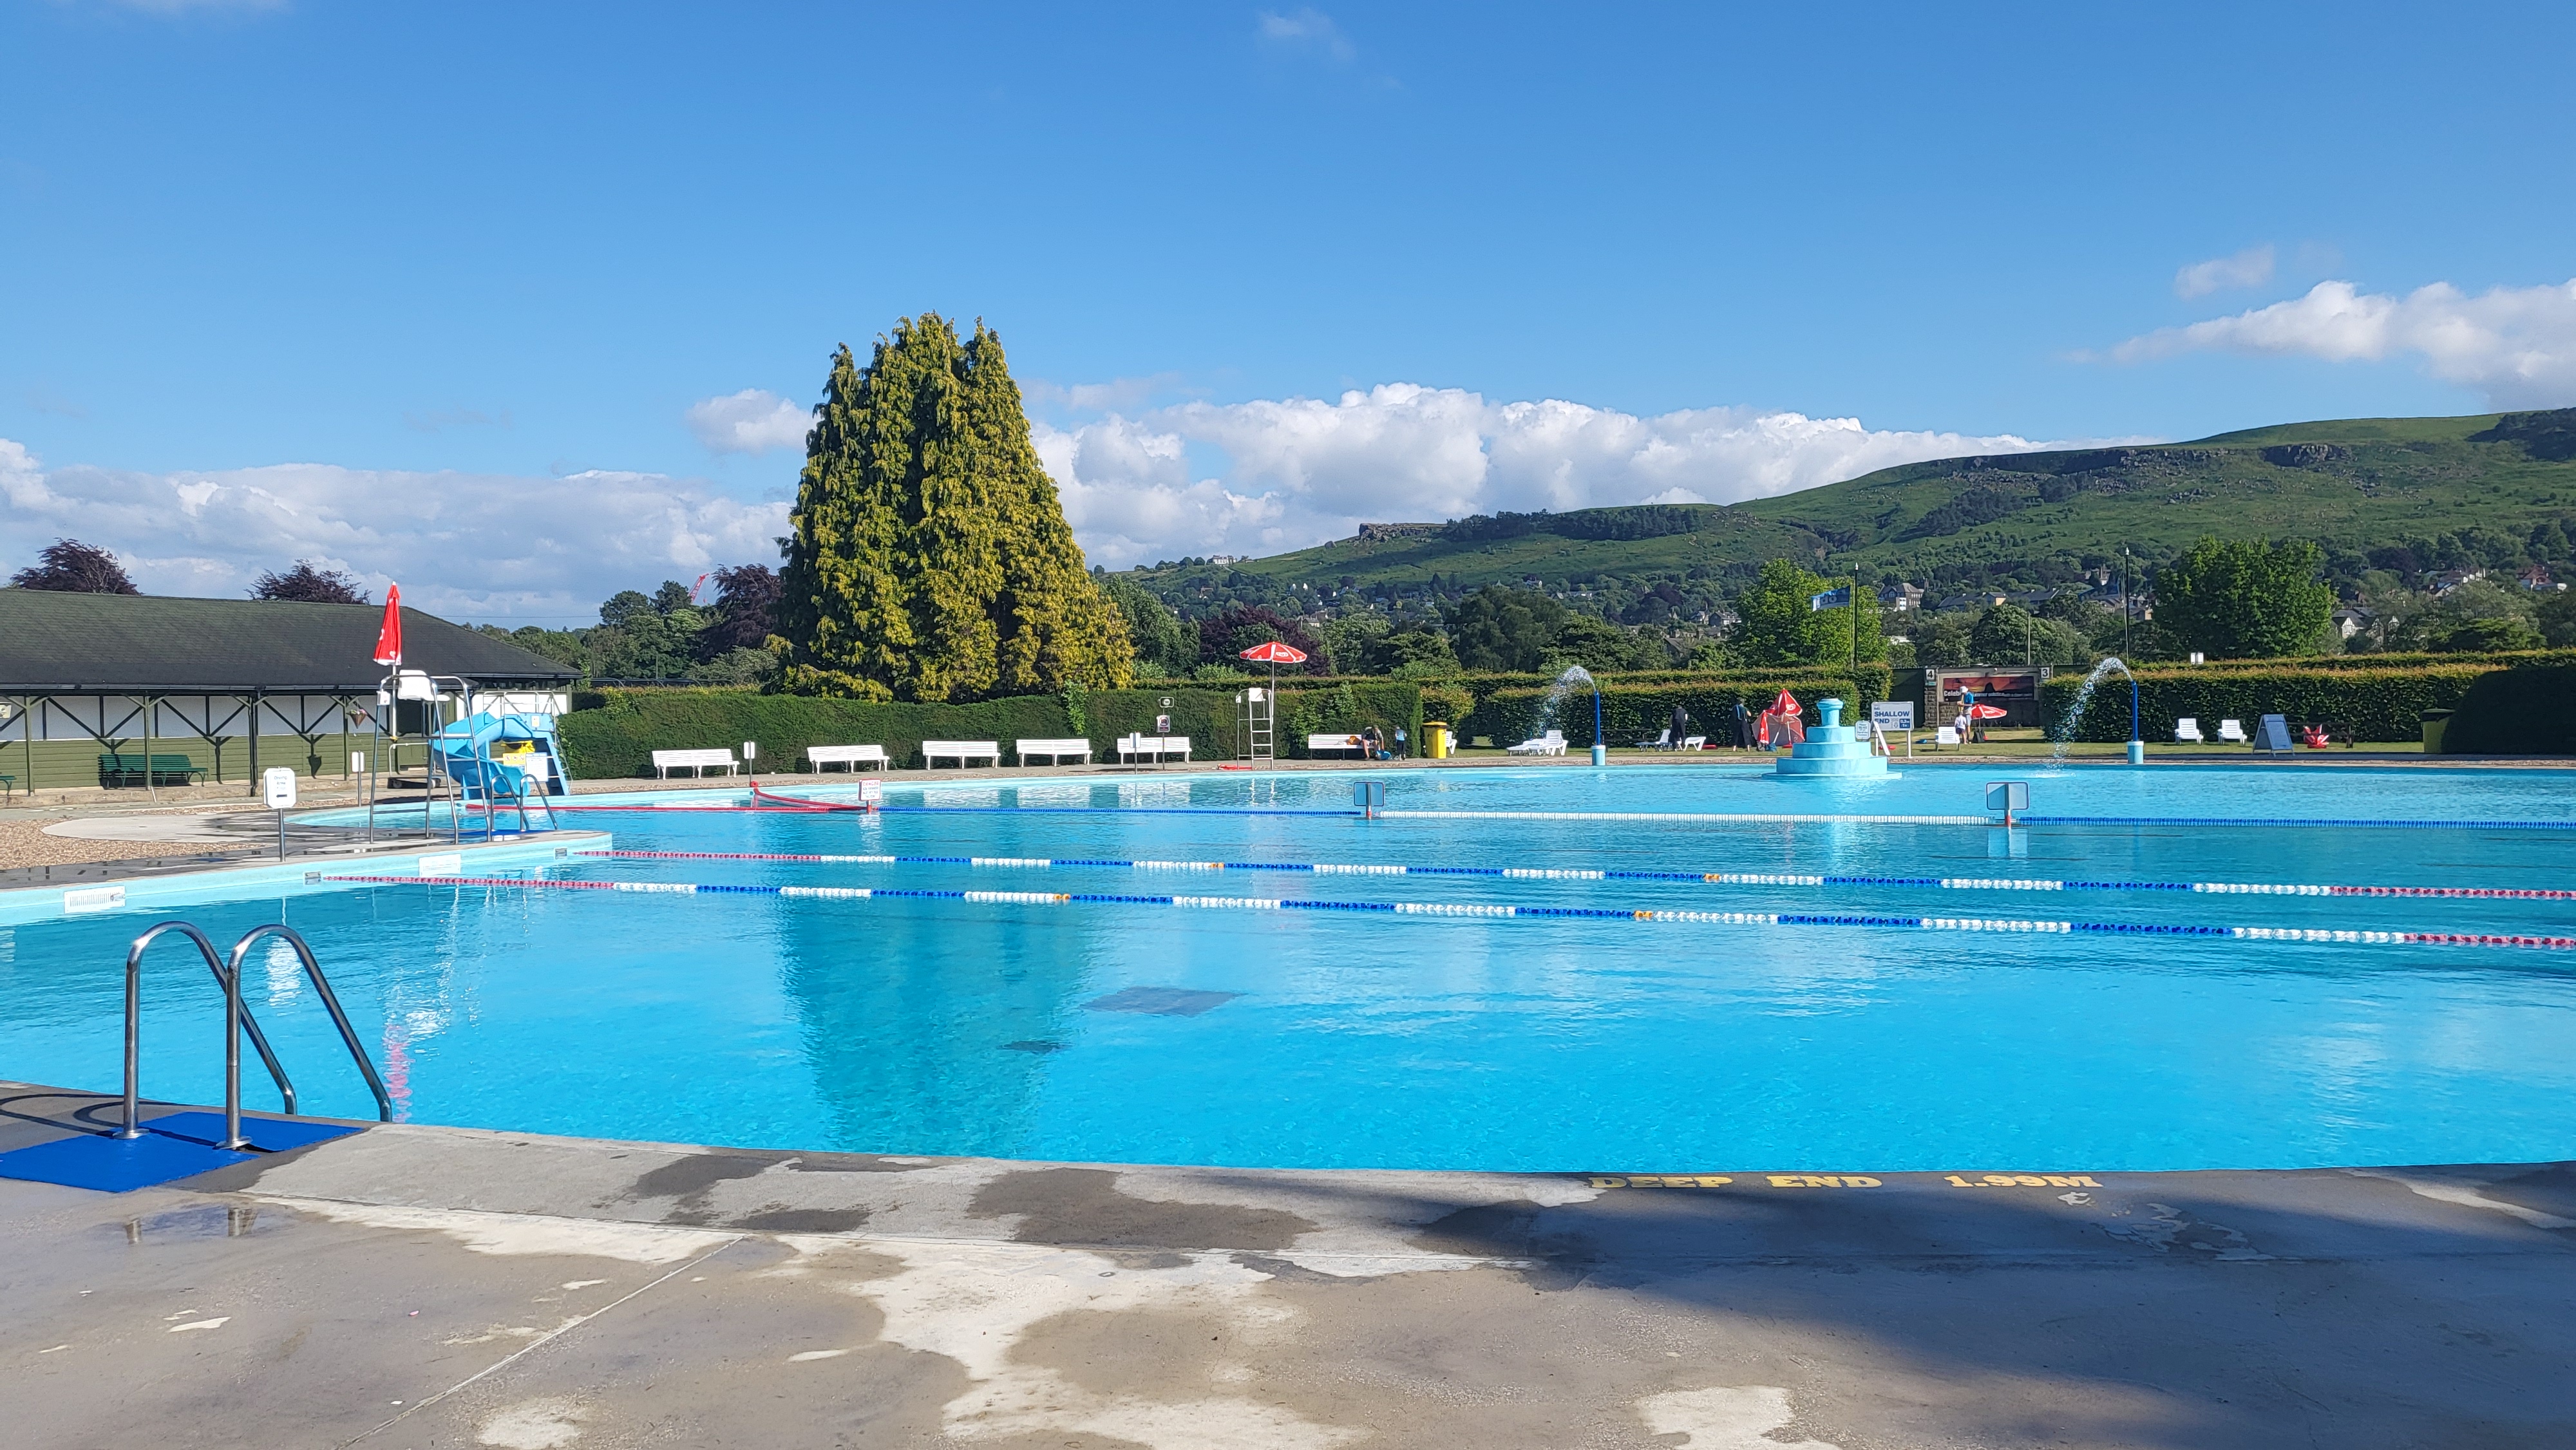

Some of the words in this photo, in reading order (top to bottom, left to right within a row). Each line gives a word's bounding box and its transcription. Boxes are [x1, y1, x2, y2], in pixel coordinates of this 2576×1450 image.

[1927, 670, 1933, 679] 4
[2042, 668, 2048, 677] 3
[1588, 1176, 1733, 1188] DEEP
[1766, 1175, 1882, 1188] END
[1944, 1175, 2104, 1187] 1.99M
